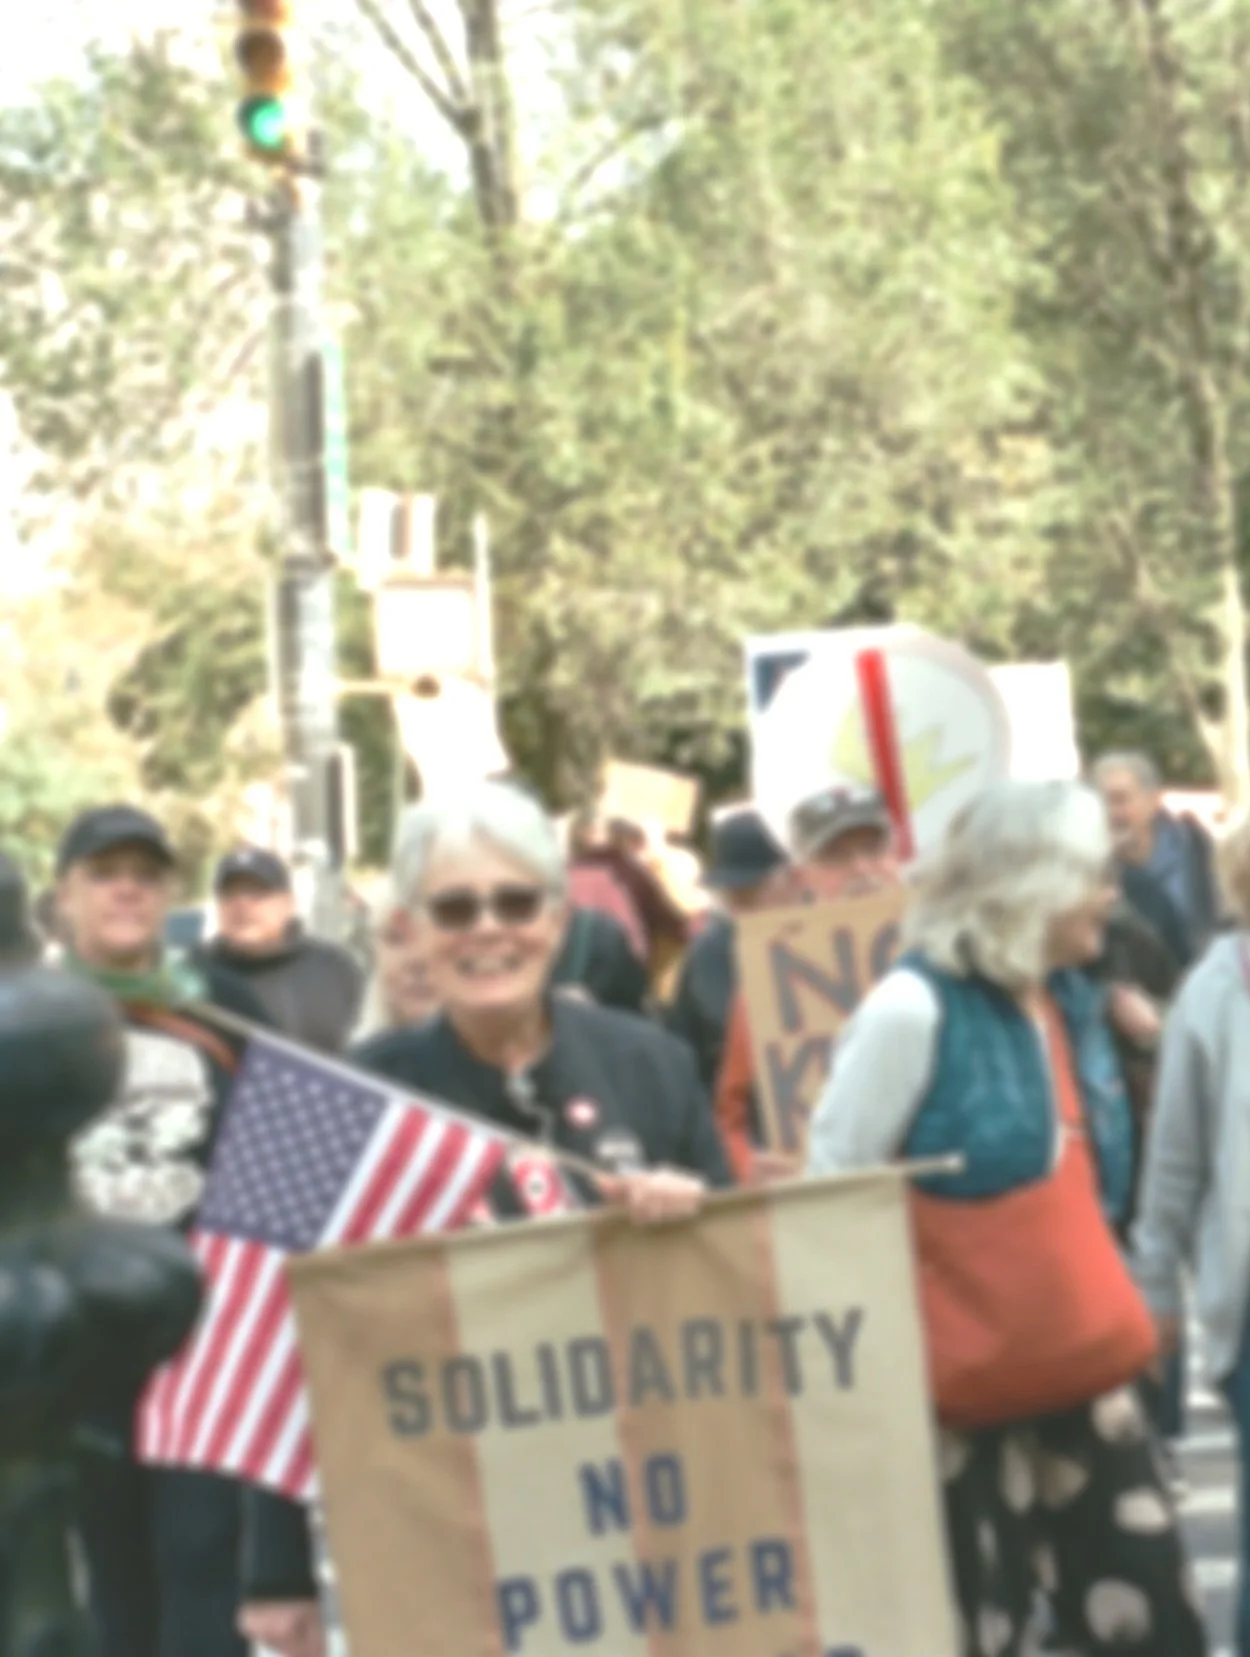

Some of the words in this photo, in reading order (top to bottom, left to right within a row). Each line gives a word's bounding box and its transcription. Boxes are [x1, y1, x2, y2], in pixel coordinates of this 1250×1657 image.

[380, 1306, 866, 1438] SOLIDARITY
[577, 1452, 689, 1538] NO
[493, 1537, 798, 1653] POWER
